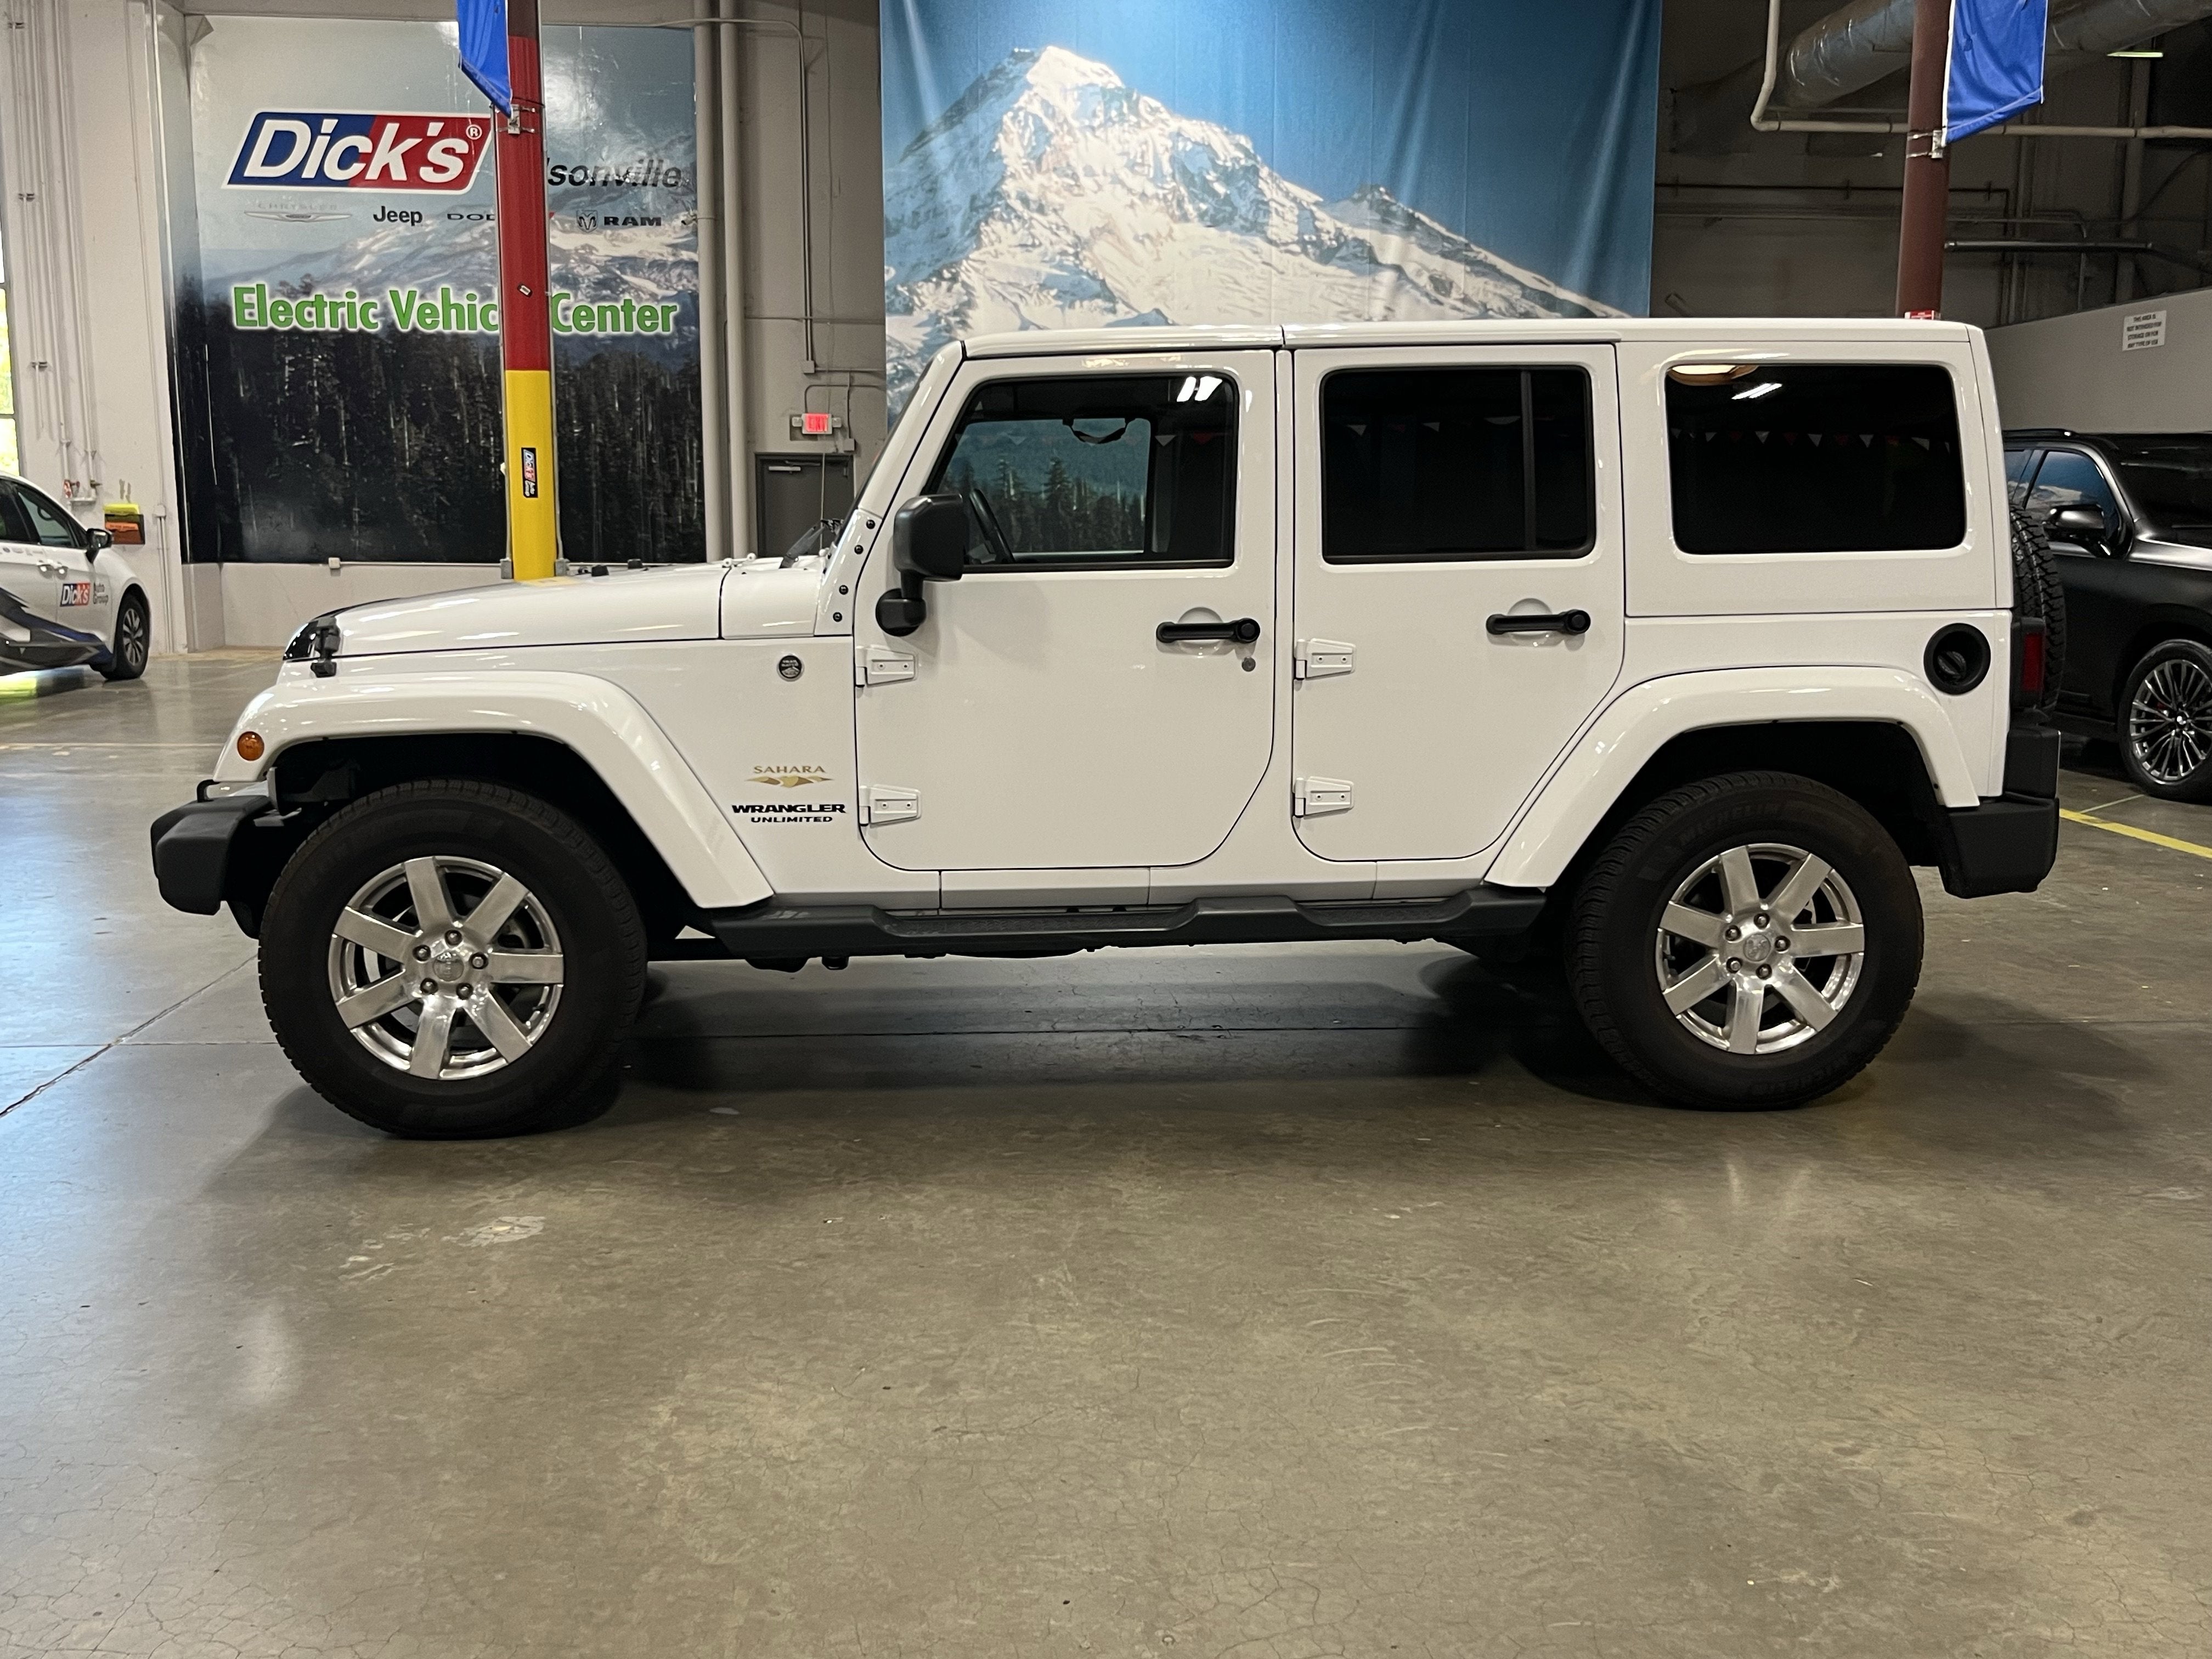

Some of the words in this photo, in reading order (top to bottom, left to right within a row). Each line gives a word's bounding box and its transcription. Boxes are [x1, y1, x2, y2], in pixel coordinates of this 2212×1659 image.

[547, 157, 682, 188] sonville
[373, 205, 423, 227] Jeep
[604, 216, 662, 226] RAM
[234, 284, 379, 330] Electric
[389, 287, 498, 331] Vehic
[552, 292, 678, 333] Center
[753, 765, 827, 774] SAHARA
[731, 804, 847, 814] WRANGLER
